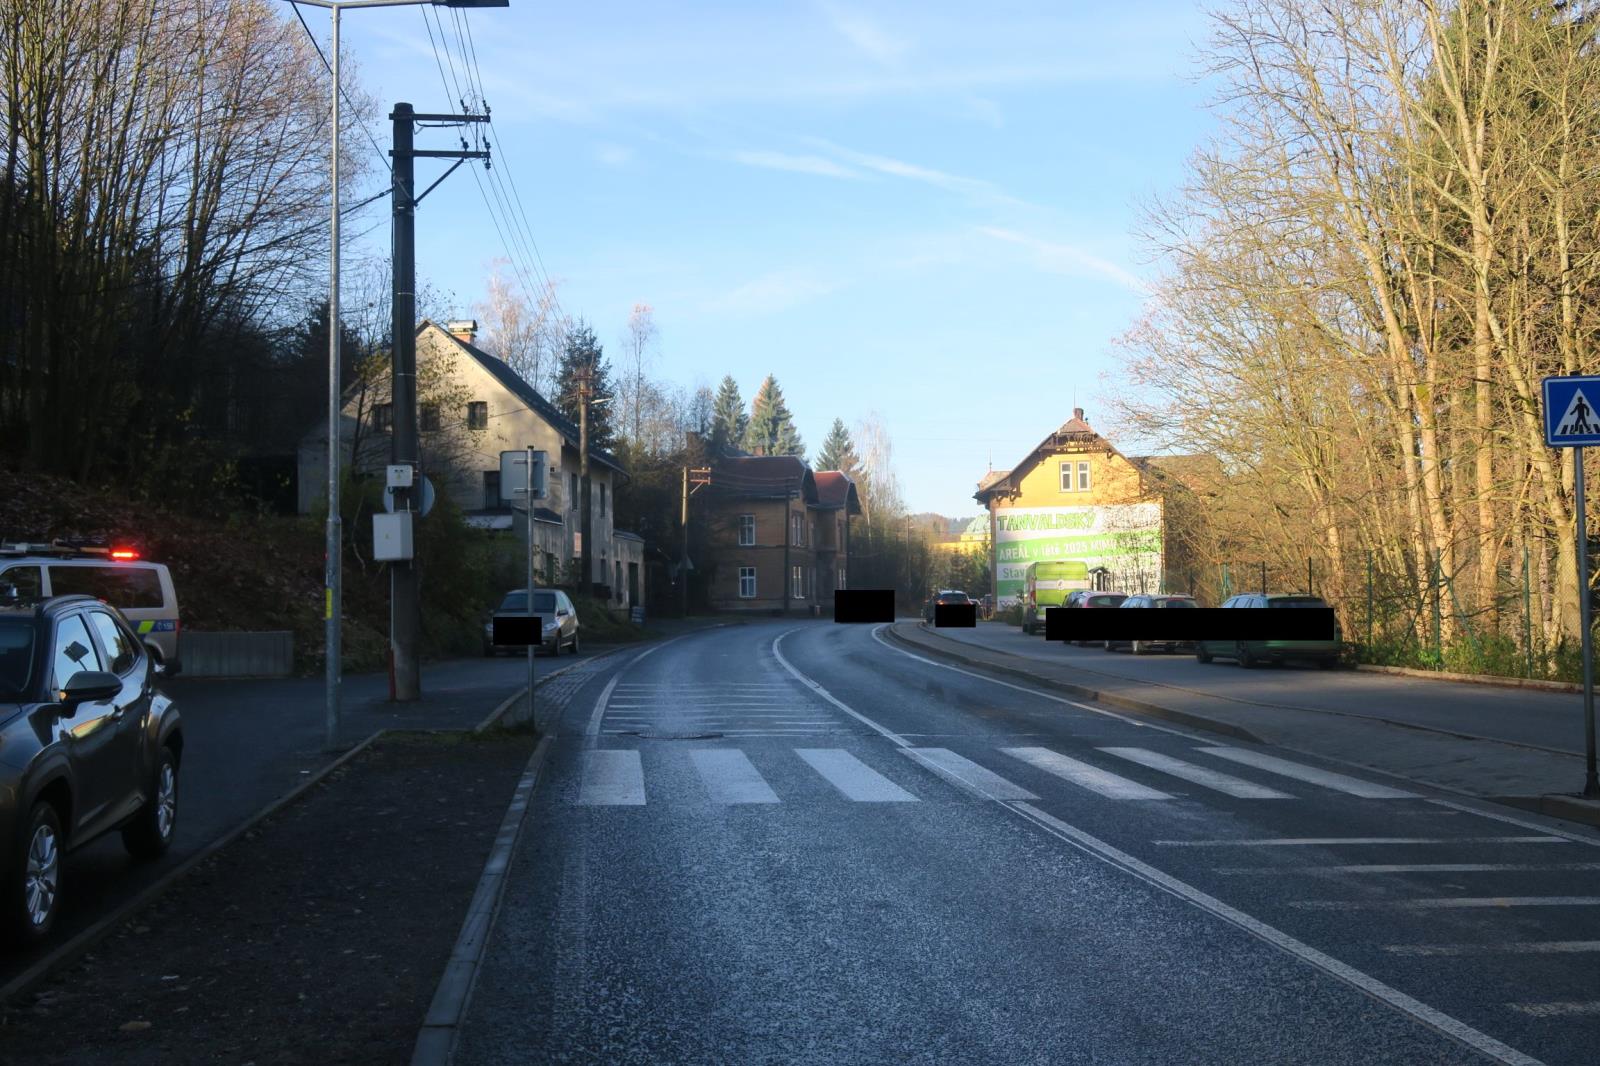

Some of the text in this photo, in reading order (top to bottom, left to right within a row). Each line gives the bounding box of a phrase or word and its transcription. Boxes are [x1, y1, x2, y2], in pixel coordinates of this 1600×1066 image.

[997, 509, 1096, 530] TANVALDSKÝ
[999, 544, 1030, 560] AREÁL
[1064, 542, 1088, 553] 2025
